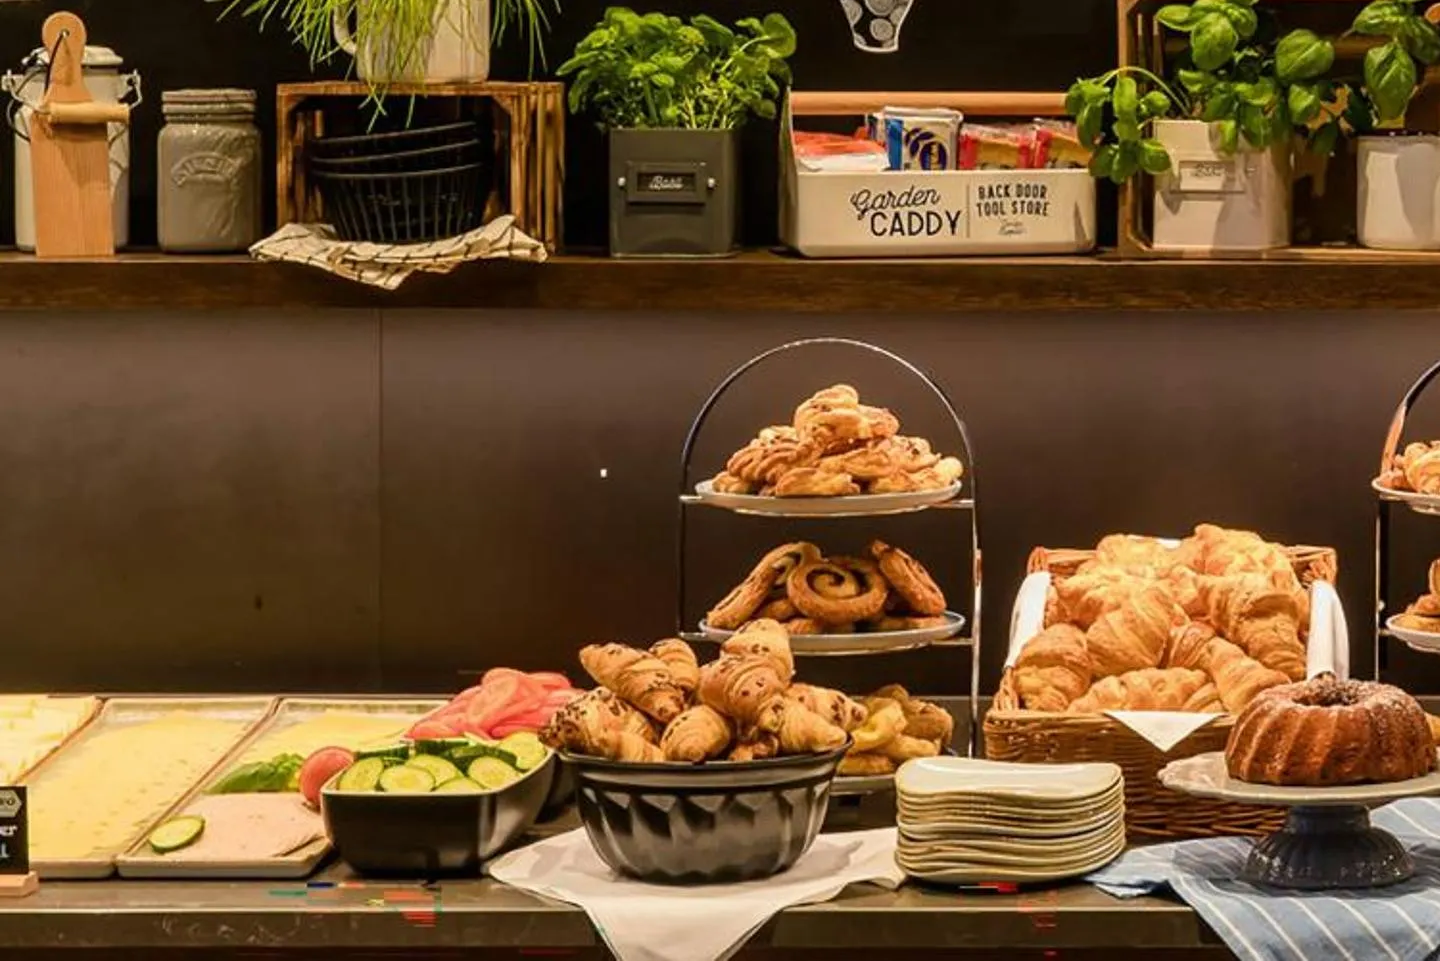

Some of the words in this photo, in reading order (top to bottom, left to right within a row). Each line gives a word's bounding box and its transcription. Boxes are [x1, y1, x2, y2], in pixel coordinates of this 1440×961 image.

[978, 185, 1010, 200] BACK
[1016, 183, 1048, 199] DOOR
[850, 185, 941, 221] Garden
[976, 201, 1006, 217] TOOL
[1011, 200, 1050, 217] STORE
[870, 210, 961, 237] CADDY
